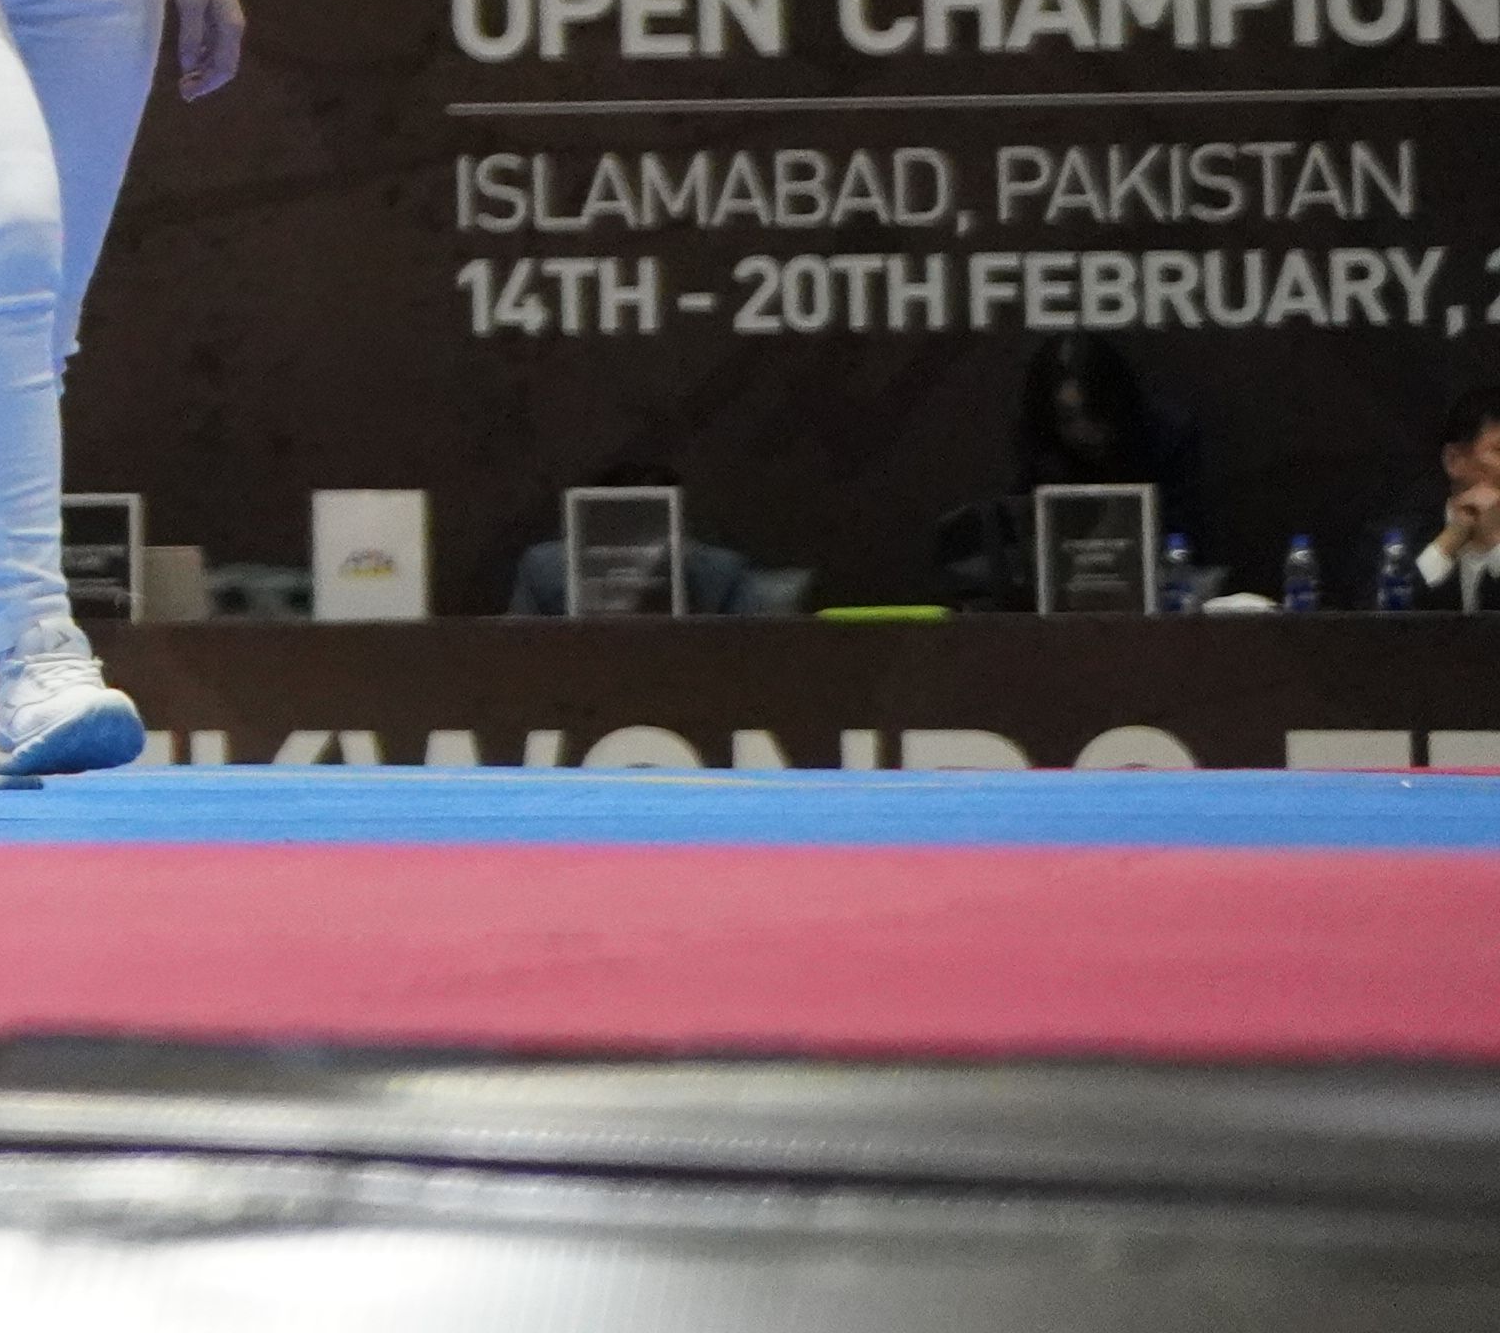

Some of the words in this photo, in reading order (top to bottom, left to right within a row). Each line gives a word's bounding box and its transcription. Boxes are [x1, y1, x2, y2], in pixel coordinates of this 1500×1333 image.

[455, 147, 974, 234] ISLAMABAD,
[995, 141, 1415, 225] PAKISTAN
[455, 256, 662, 336] 14TH
[733, 253, 948, 333] 20TH
[970, 246, 1462, 336] FEBRUARY,
